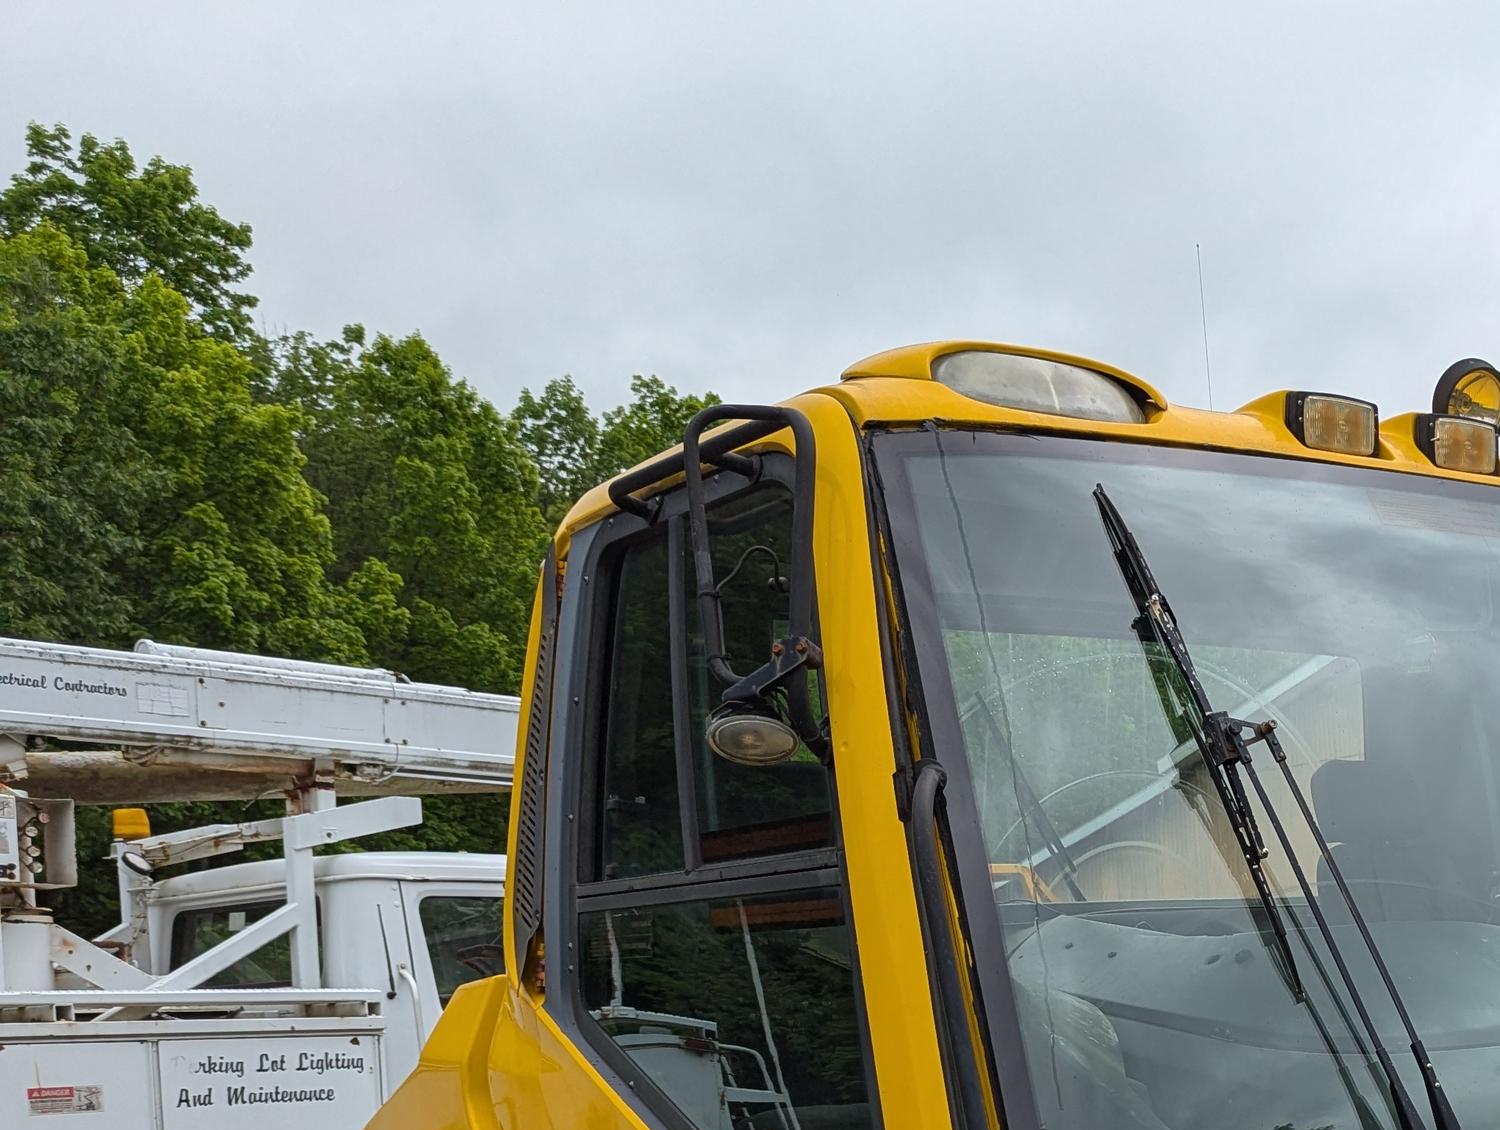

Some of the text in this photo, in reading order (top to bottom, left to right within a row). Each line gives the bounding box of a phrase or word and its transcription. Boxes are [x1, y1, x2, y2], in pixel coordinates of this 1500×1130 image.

[54, 676, 127, 697] Contractors
[256, 1053, 286, 1073] Lot
[176, 1085, 336, 1108] And Maintenance
